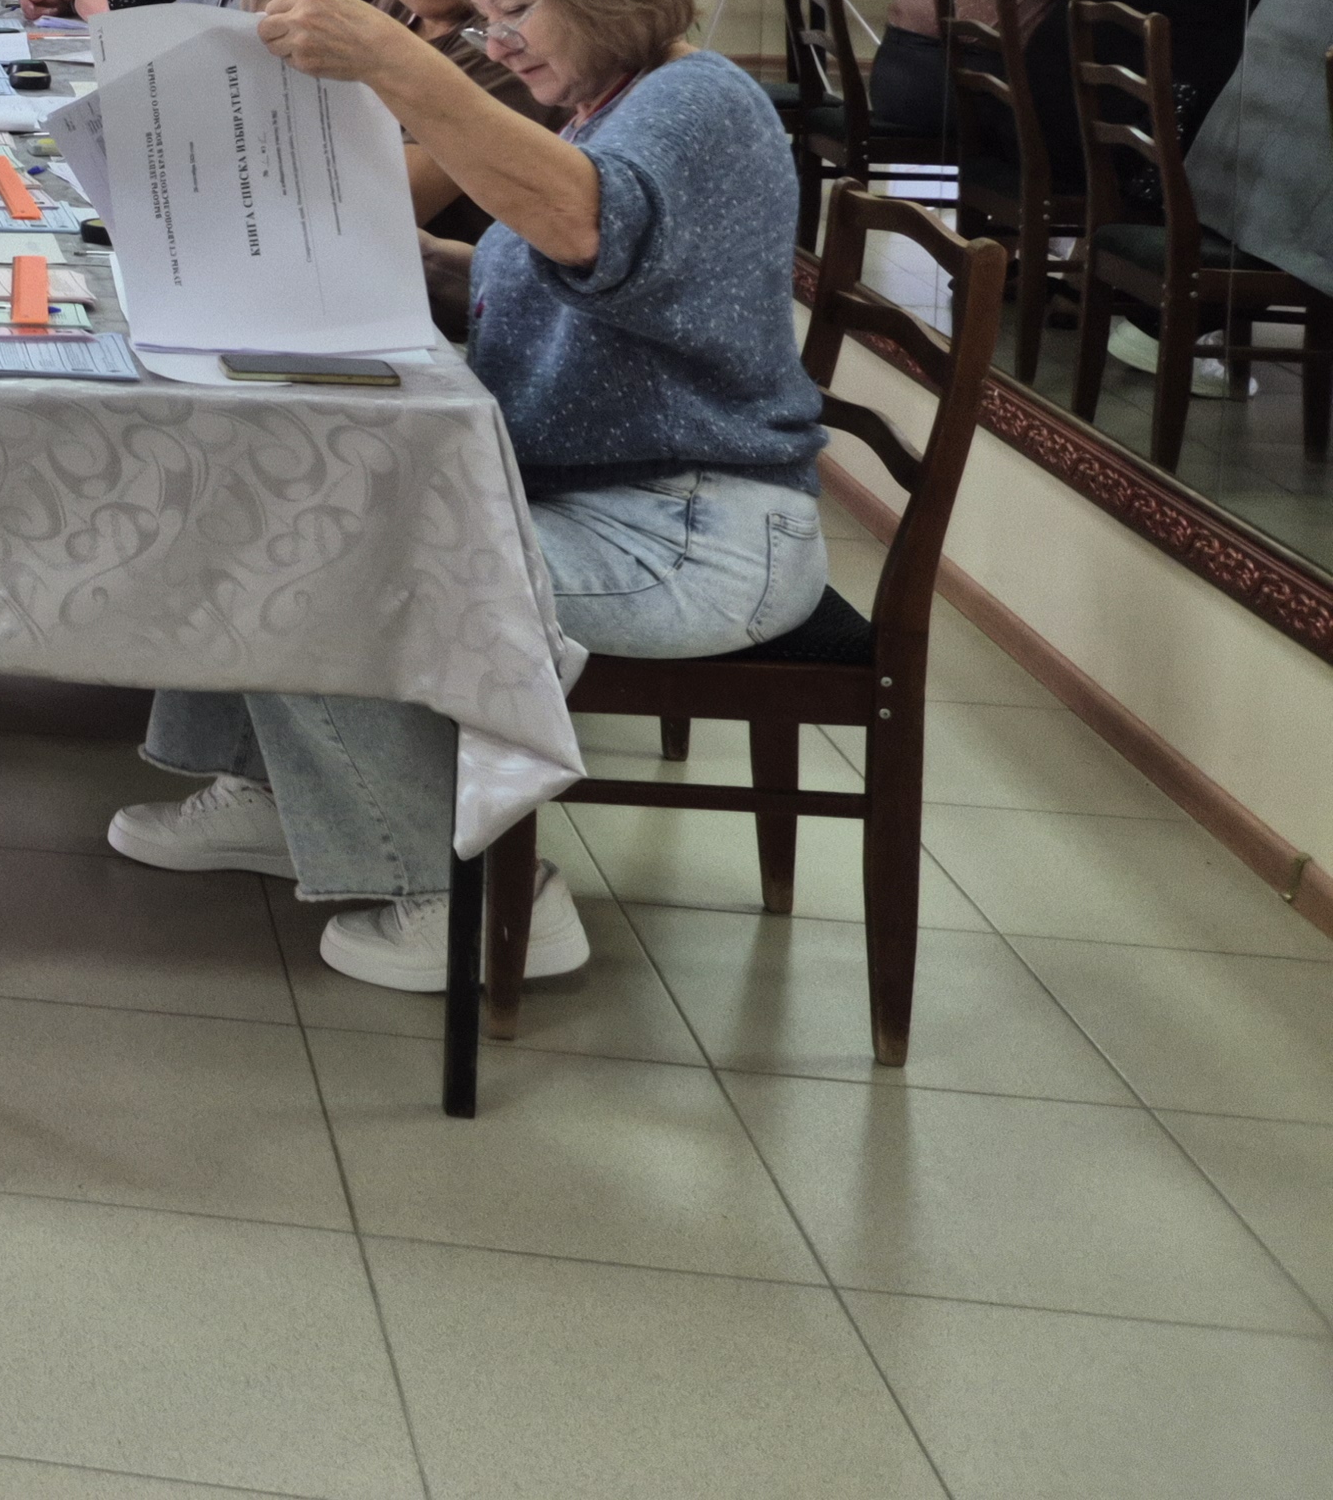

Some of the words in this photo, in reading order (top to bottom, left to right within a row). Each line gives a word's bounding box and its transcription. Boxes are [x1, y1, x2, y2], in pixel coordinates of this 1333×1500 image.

[147, 61, 158, 98] СОЗЫВА
[152, 100, 163, 146] ВОСЬМОГО
[226, 65, 246, 152] ИЗБИРАТЕЛЕЙ
[146, 132, 157, 179] ДЕПУТАТОВ
[151, 182, 162, 218] ВЫБОРЫ
[238, 156, 253, 208] СПИСКА
[160, 171, 176, 257] СТАВРОПОЛЬСКОГО
[246, 212, 260, 257] КНИГА
[171, 259, 182, 286] ДУМЫ
